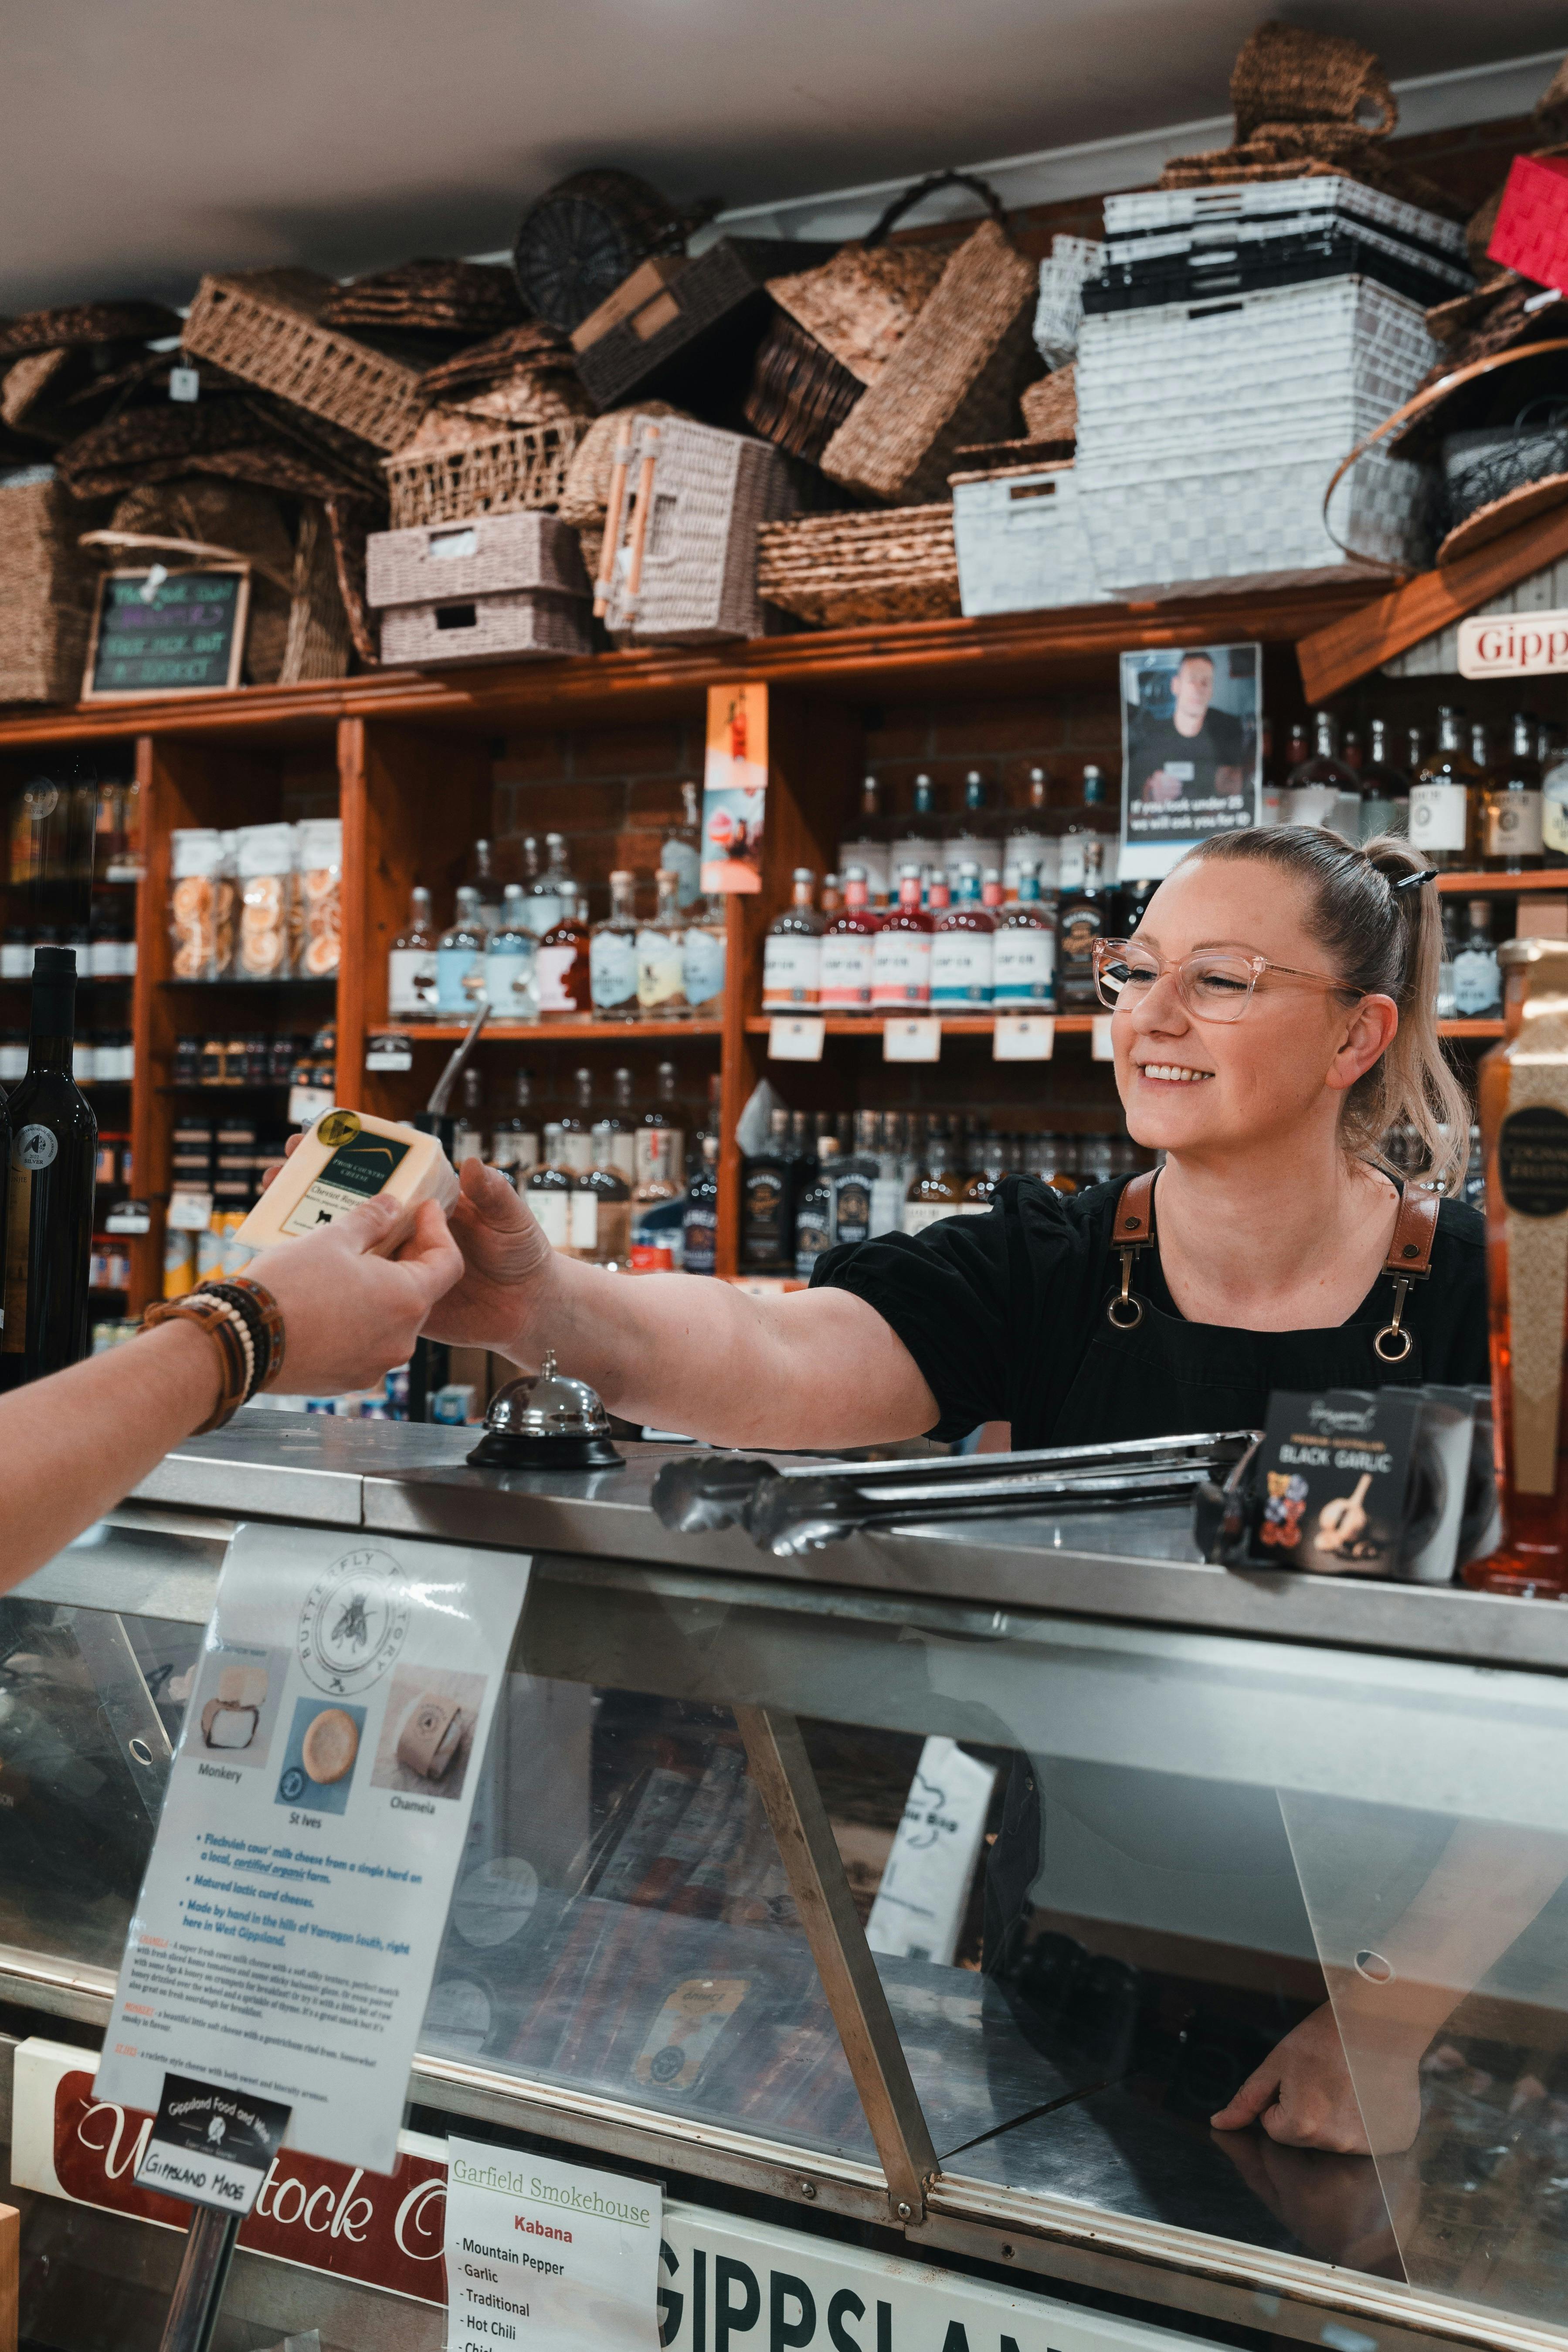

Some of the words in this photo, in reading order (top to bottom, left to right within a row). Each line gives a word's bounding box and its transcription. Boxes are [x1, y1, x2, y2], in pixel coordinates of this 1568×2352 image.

[1130, 799, 1142, 814] If
[1142, 803, 1163, 815] you
[1164, 798, 1190, 813] look
[1190, 796, 1227, 811] under
[1227, 795, 1244, 809] 25
[1150, 815, 1170, 830] will
[1171, 814, 1193, 829] ask
[1194, 816, 1216, 831] you
[1215, 812, 1235, 827] for
[340, 1168, 368, 1182] CHEESE
[1279, 1444, 1330, 1466] BLACK
[1334, 1449, 1393, 1473] GARLIC
[199, 1764, 242, 1784] Monkery
[289, 1812, 301, 1825] St
[302, 1815, 322, 1829] Ives
[295, 1850, 323, 1864] cheese
[325, 1856, 347, 1869] from
[357, 1862, 384, 1877] single
[386, 1867, 409, 1881] herd
[194, 1875, 232, 1890] Matured
[233, 1882, 256, 1895] lactic
[258, 1887, 278, 1899] curd
[280, 1891, 315, 1907] cheeses.
[183, 1915, 202, 1927] here
[204, 1920, 213, 1929] in
[215, 1922, 236, 1934] West
[238, 1926, 287, 1948] Gippsland.
[188, 1900, 212, 1913] Made
[214, 1905, 226, 1918] by
[227, 1907, 251, 1921] hand
[251, 1912, 261, 1923] in
[262, 1914, 278, 1926] the
[278, 1918, 297, 1931] hills
[298, 1921, 309, 1933] of
[309, 1925, 354, 1944] Yarragon
[355, 1933, 385, 1951] South,
[386, 1939, 409, 1955] right
[168, 2096, 212, 2116] Gippsland
[213, 2096, 238, 2116] Food
[237, 2109, 255, 2126] and
[453, 2159, 523, 2193] Garfield
[530, 2178, 650, 2223] Smokehouse
[514, 2215, 573, 2243] Kabana
[462, 2238, 519, 2264] Mountain
[523, 2254, 564, 2276] Pepper
[465, 2264, 498, 2283] Garlic
[466, 2288, 529, 2317] Traditional
[467, 2315, 487, 2332] Hot
[492, 2323, 516, 2340] Chili
